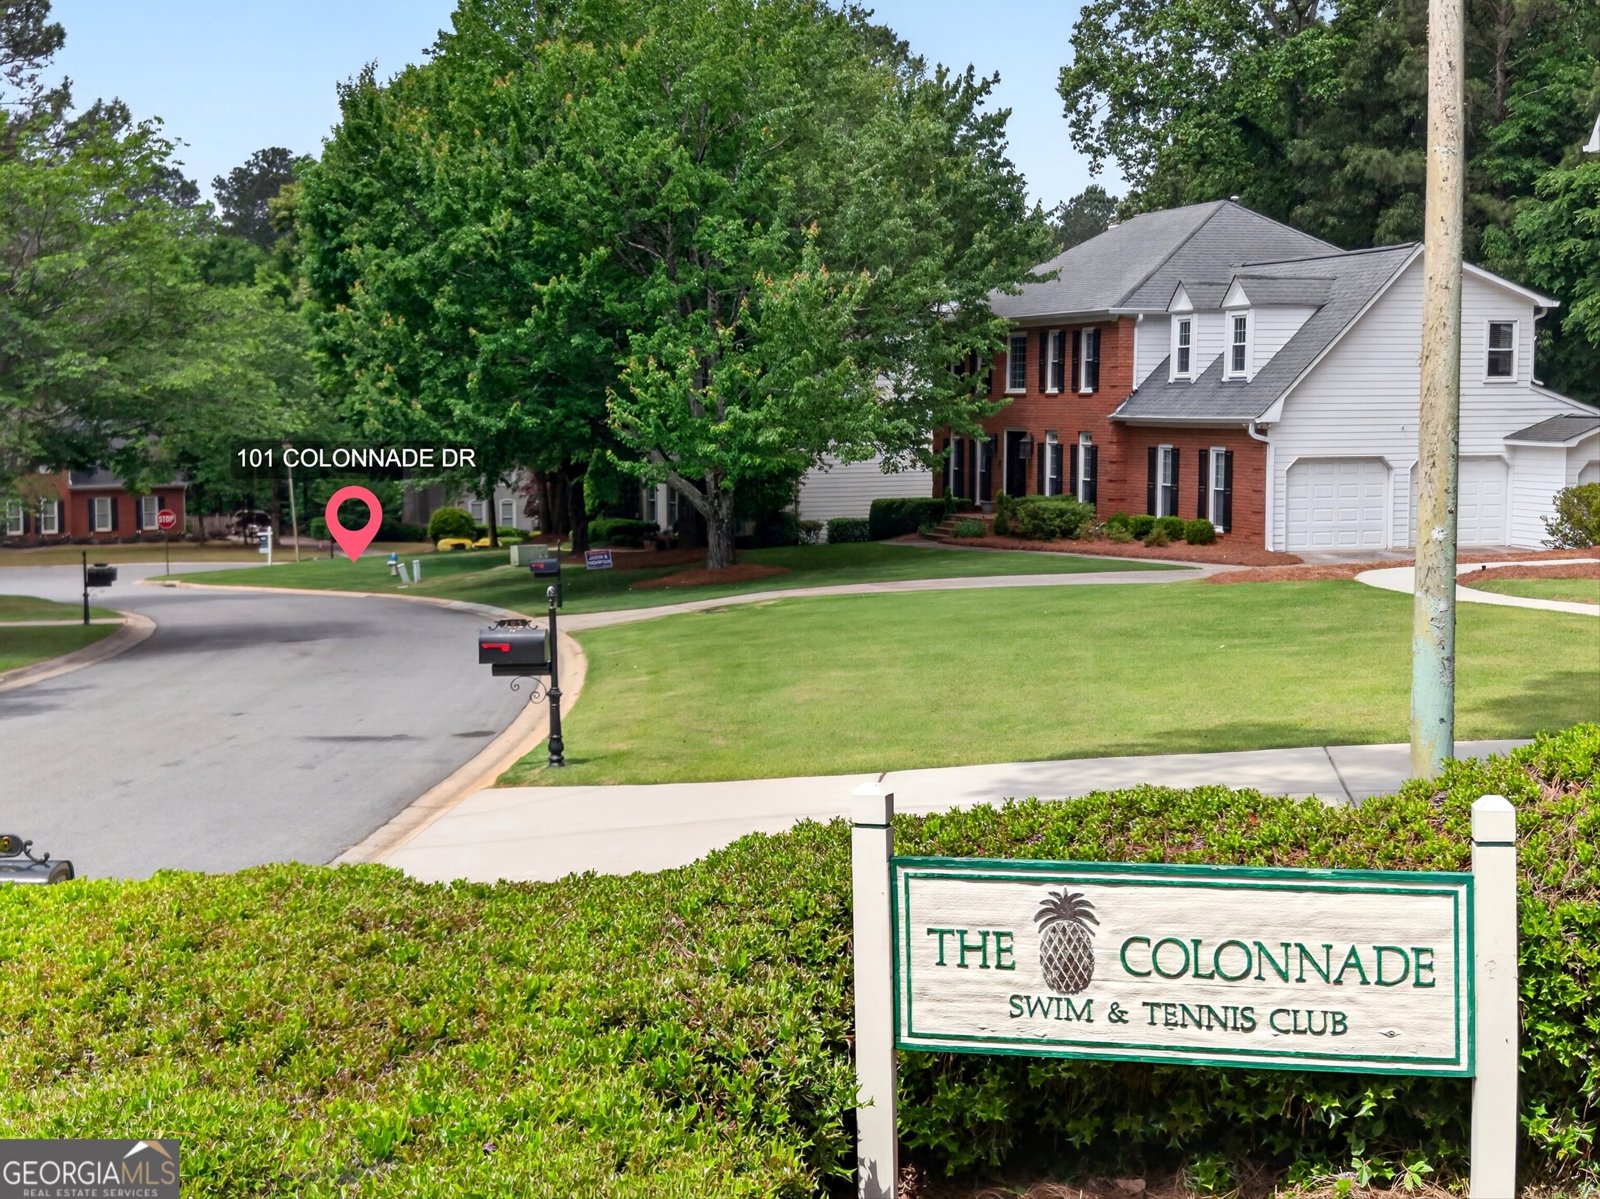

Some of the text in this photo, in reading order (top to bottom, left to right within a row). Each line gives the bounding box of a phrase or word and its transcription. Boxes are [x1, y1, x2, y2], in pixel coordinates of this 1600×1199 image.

[158, 514, 175, 523] STOP
[926, 927, 1437, 988] THE COLONNADE
[1008, 994, 1349, 1037] SWIM & TENNIS CLUB
